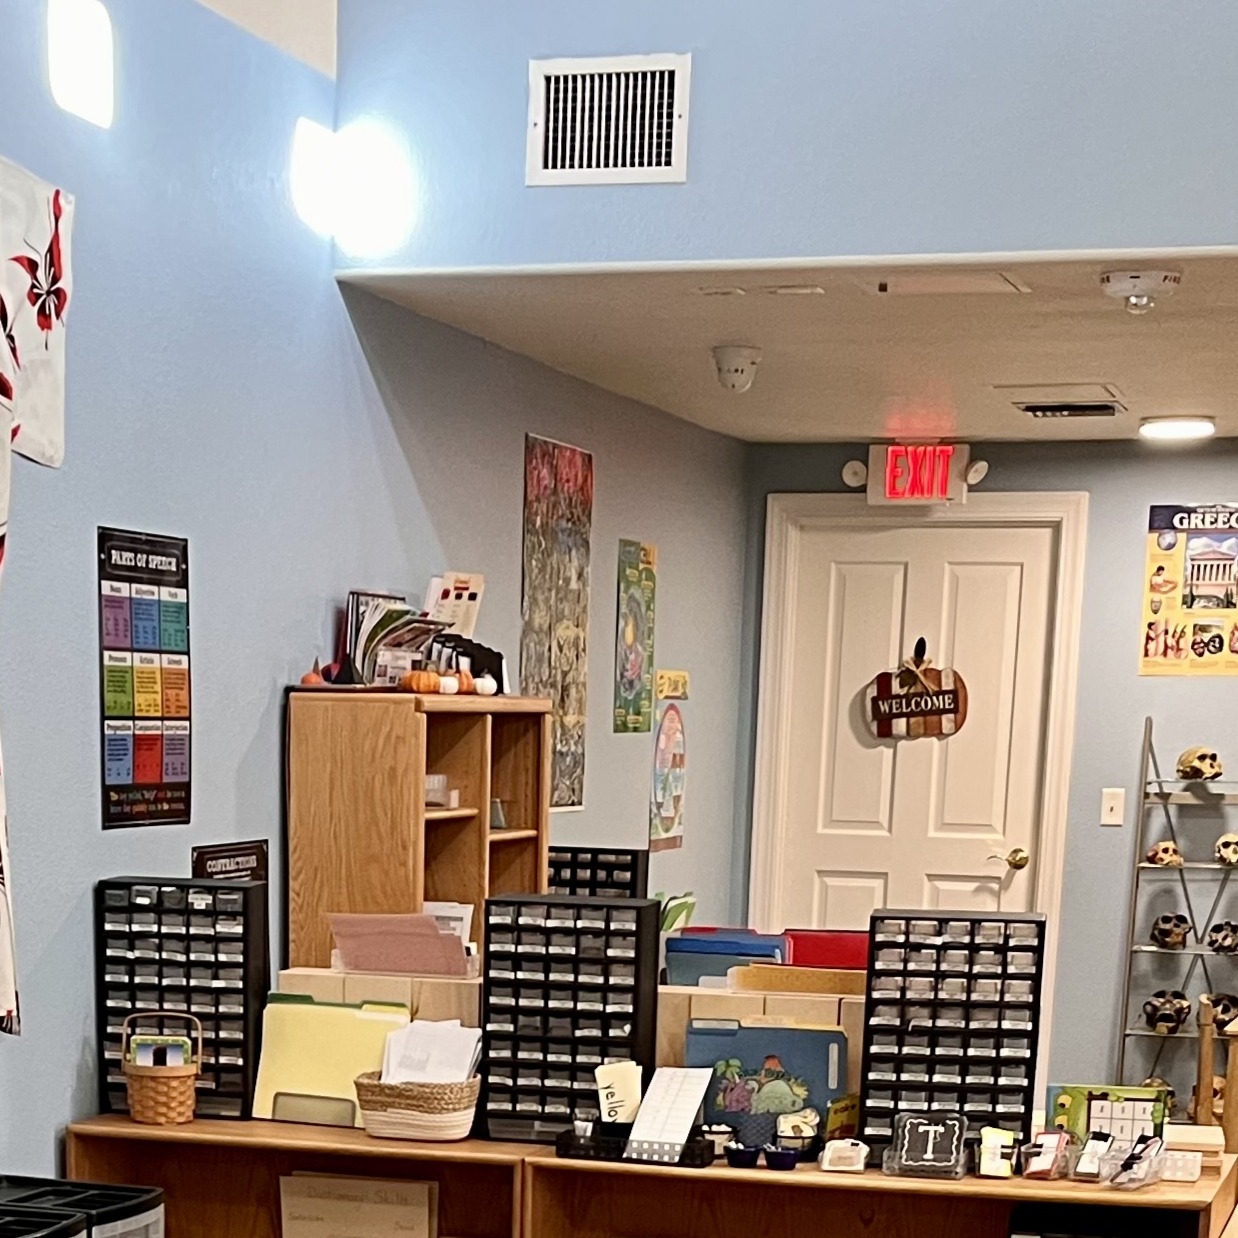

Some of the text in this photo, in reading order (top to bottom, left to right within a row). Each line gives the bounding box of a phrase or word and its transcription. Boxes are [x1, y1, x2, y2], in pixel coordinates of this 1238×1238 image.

[886, 446, 954, 498] EXIT
[111, 550, 177, 571] PARTS OF SPEECH
[878, 695, 954, 714] WELCOME
[917, 1124, 944, 1160] T
